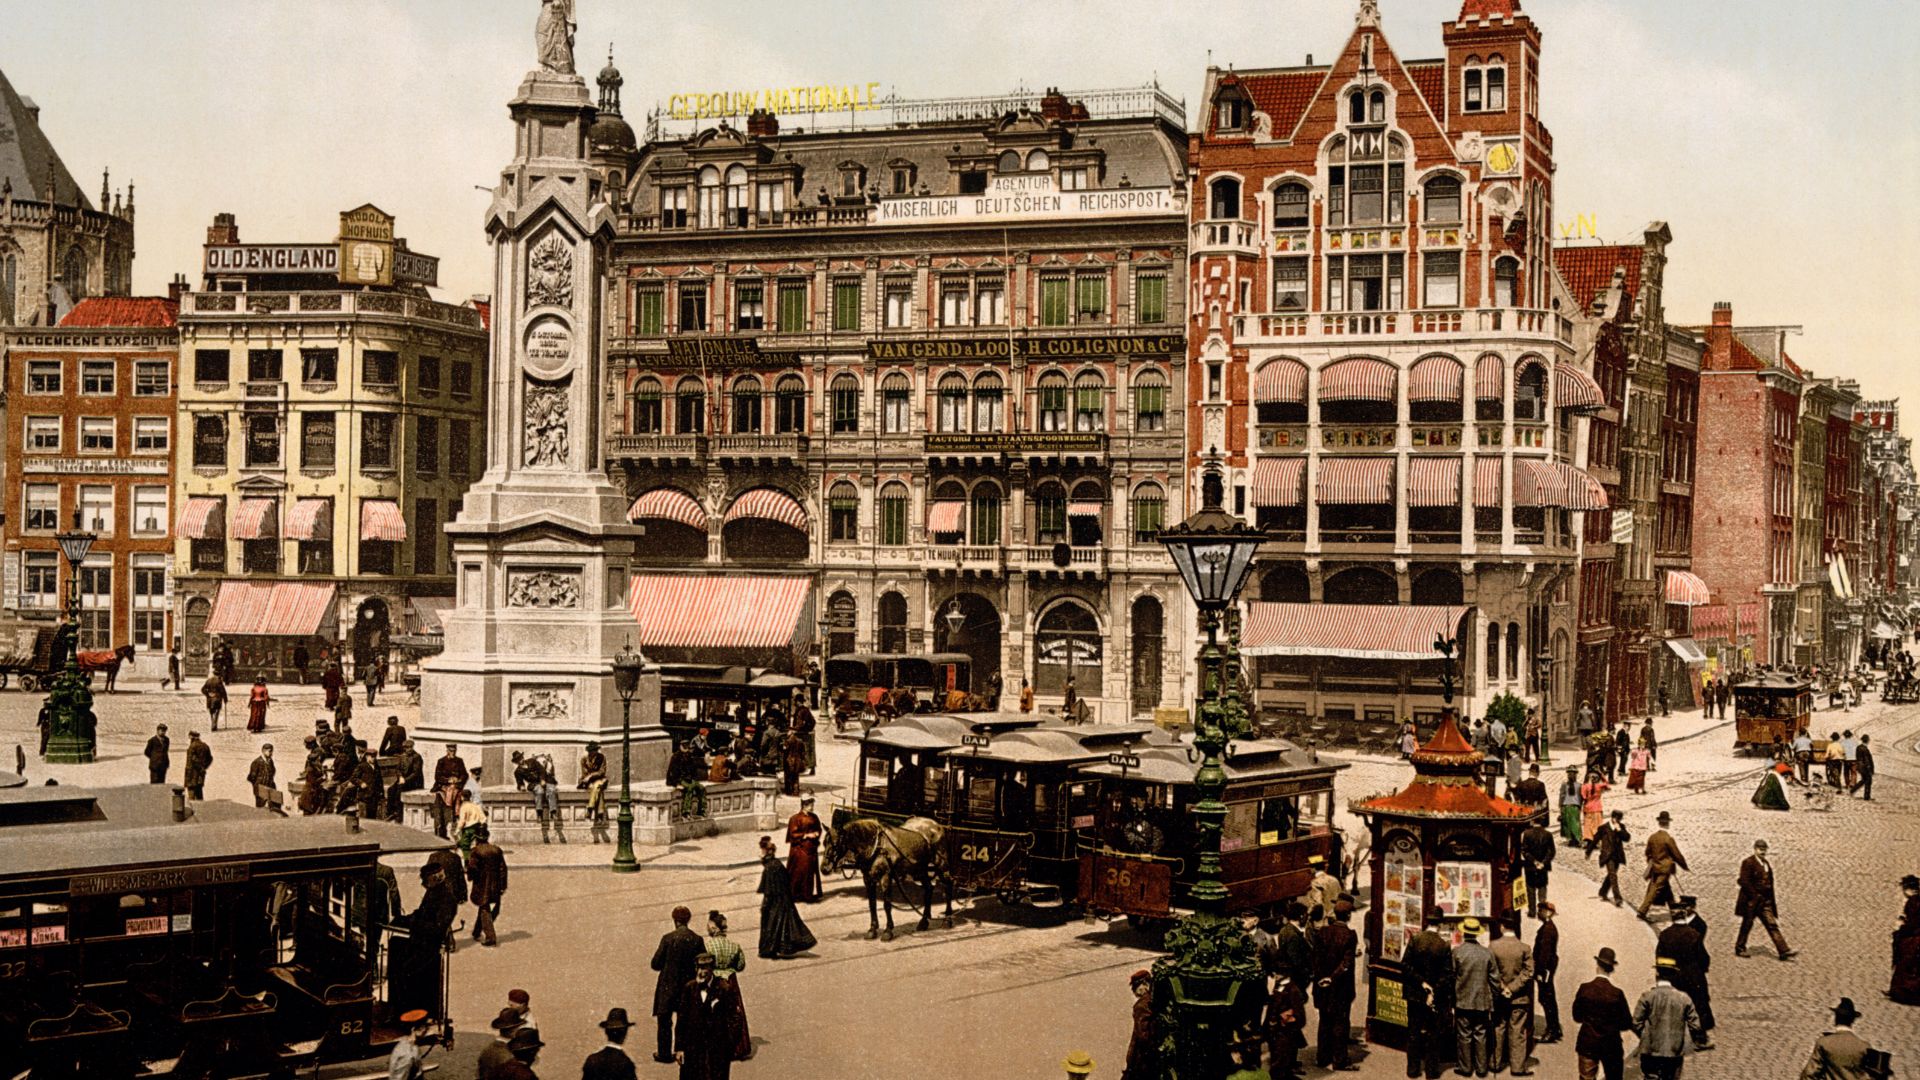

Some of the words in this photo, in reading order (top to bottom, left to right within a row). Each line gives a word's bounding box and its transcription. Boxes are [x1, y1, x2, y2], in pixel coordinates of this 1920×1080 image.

[669, 91, 759, 120] GEBOUW
[764, 81, 881, 115] NATIONALE
[995, 177, 1050, 191] AGENTUR
[883, 200, 958, 219] KAISERLICH
[975, 196, 1061, 214] DEUTSCHEN
[348, 224, 389, 240] HOFHUIS
[208, 249, 244, 269] OLD
[245, 249, 337, 269] ENGLAND
[104, 335, 178, 346] EXPEDITIE
[671, 340, 755, 355] NATONALE
[872, 343, 908, 357] VAN
[912, 342, 962, 356] GEND
[1048, 338, 1145, 354] COLIGNON
[861, 711, 876, 720] DAM
[964, 736, 987, 745] DAM
[1111, 755, 1137, 766] DAM
[961, 845, 989, 862] 214
[1107, 868, 1131, 887] 36
[341, 1020, 363, 1034] 82
